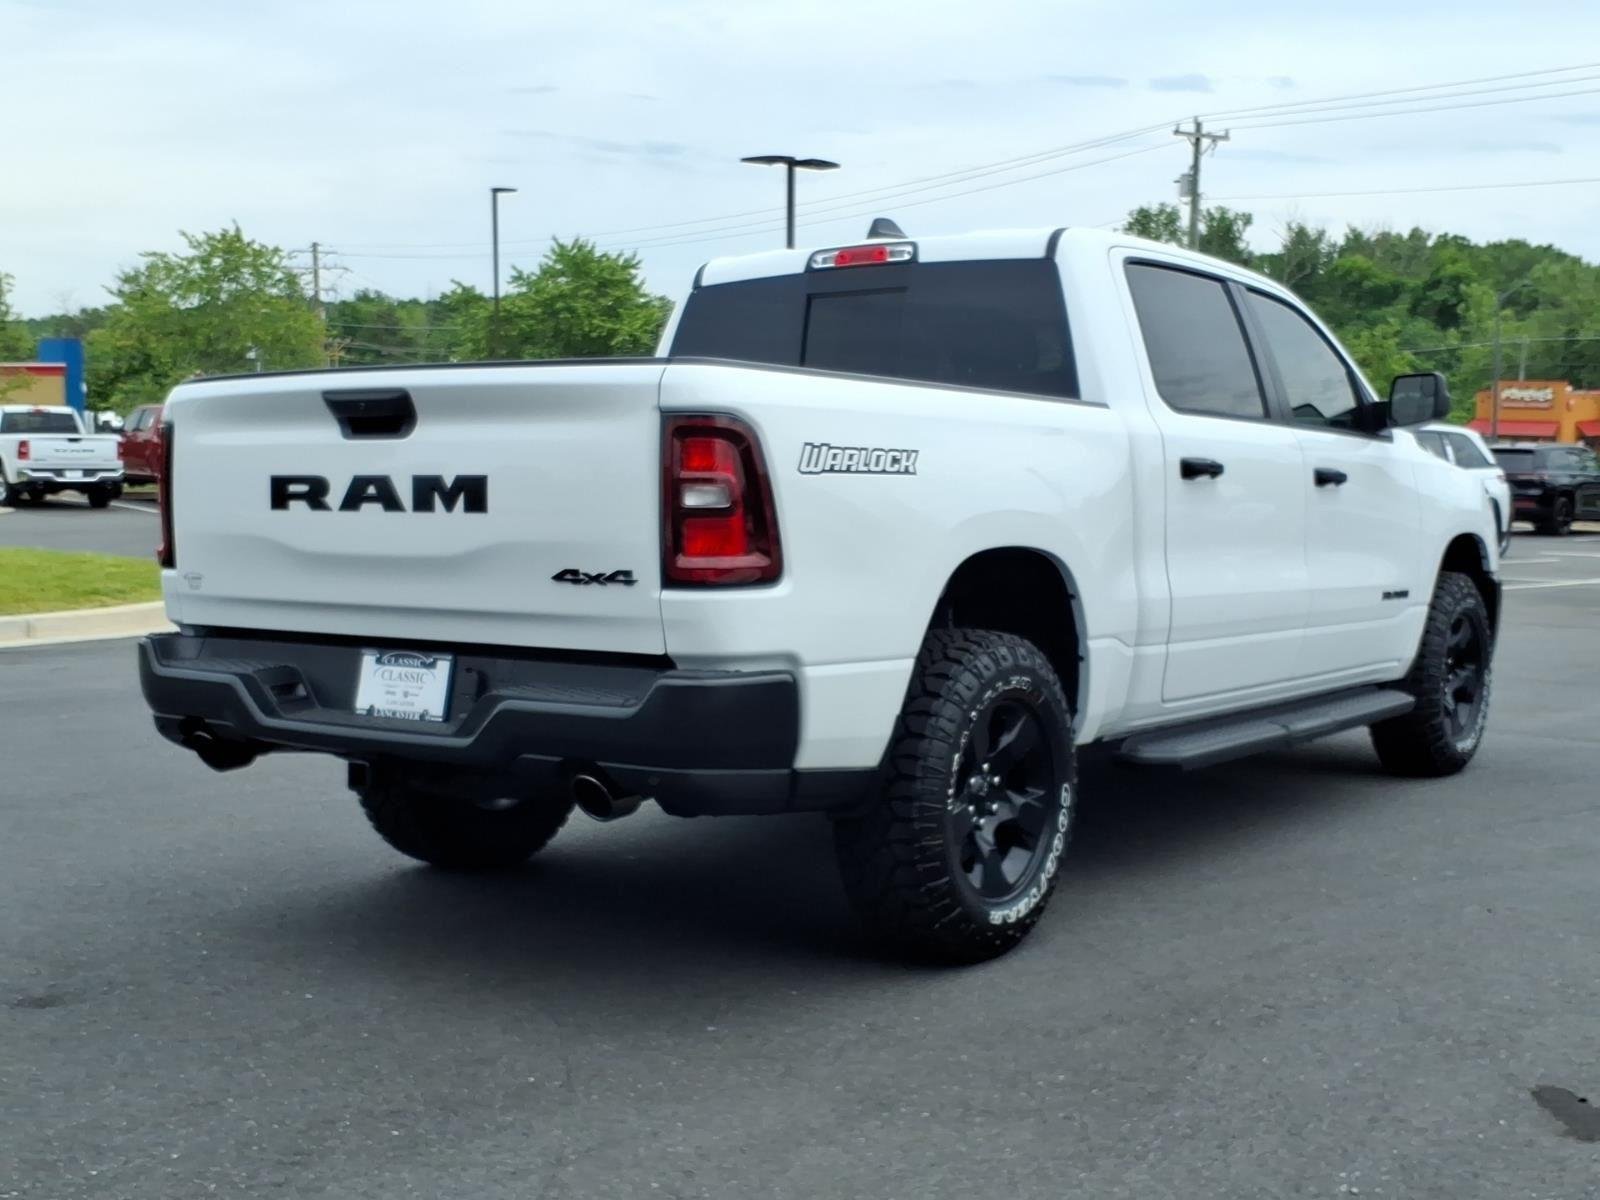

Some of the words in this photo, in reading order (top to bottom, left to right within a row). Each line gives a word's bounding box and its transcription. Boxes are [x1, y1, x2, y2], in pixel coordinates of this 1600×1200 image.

[797, 441, 919, 475] WARLOCK
[270, 474, 488, 514] RAM
[550, 567, 639, 587] 4x4
[384, 656, 425, 668] CLASSIC
[380, 668, 426, 684] CLASSIC
[374, 707, 421, 721] LANCASTER
